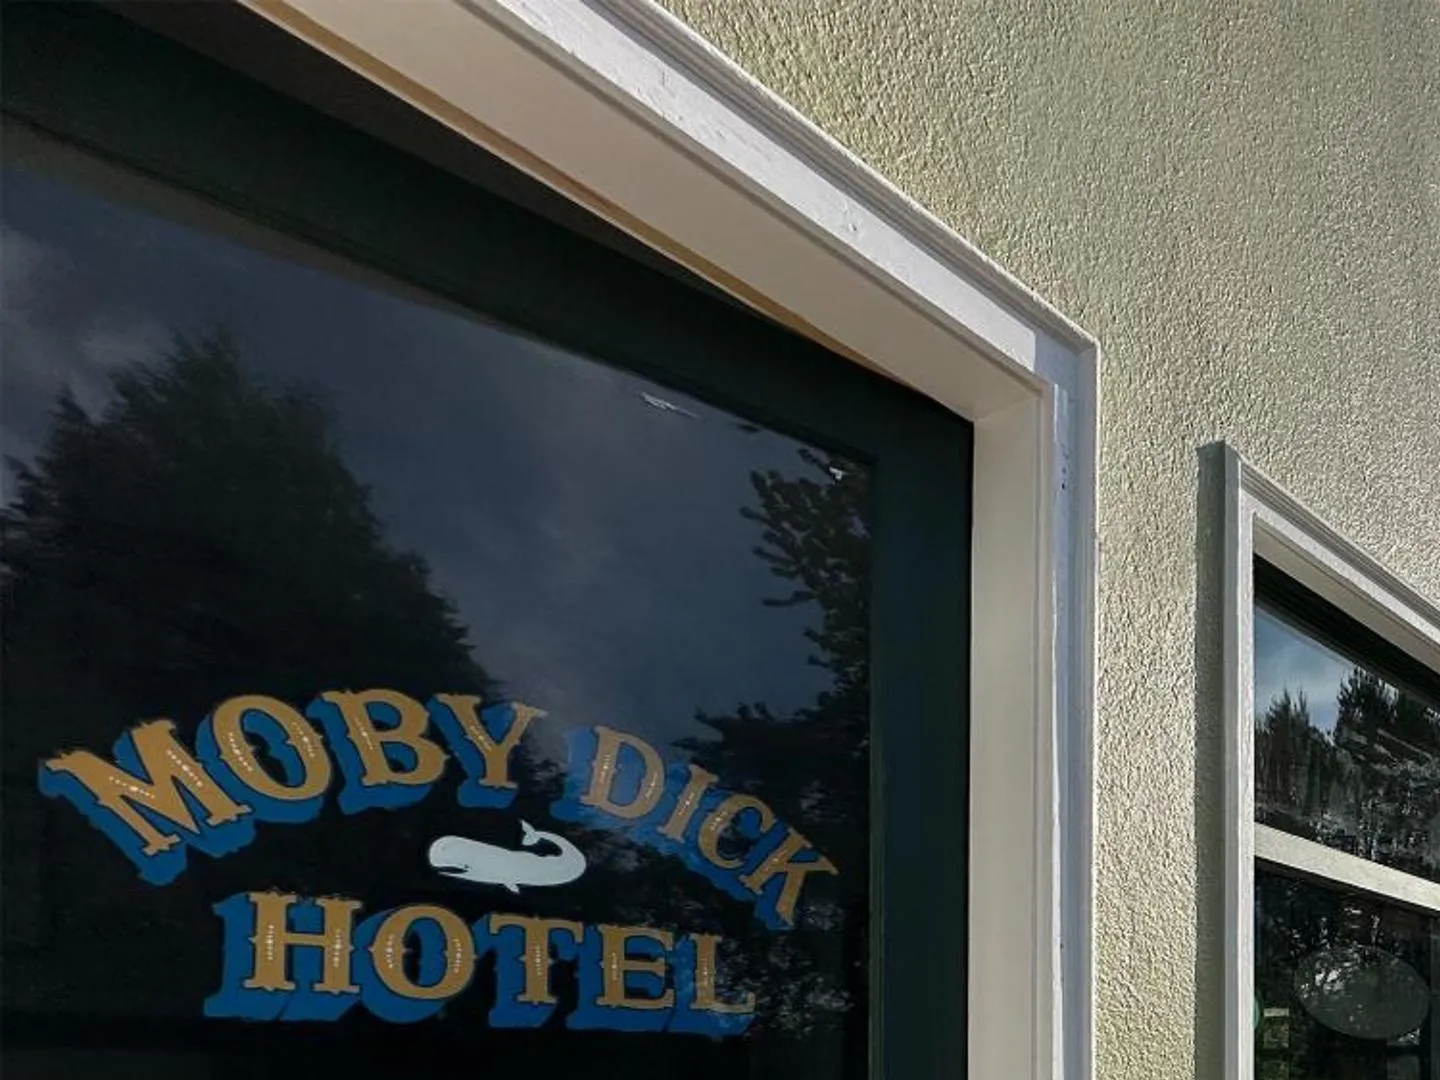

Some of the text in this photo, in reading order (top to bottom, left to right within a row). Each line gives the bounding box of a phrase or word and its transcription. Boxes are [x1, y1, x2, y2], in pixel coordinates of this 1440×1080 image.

[40, 689, 839, 930] MOBY DICK
[207, 890, 756, 1033] HOTEL
